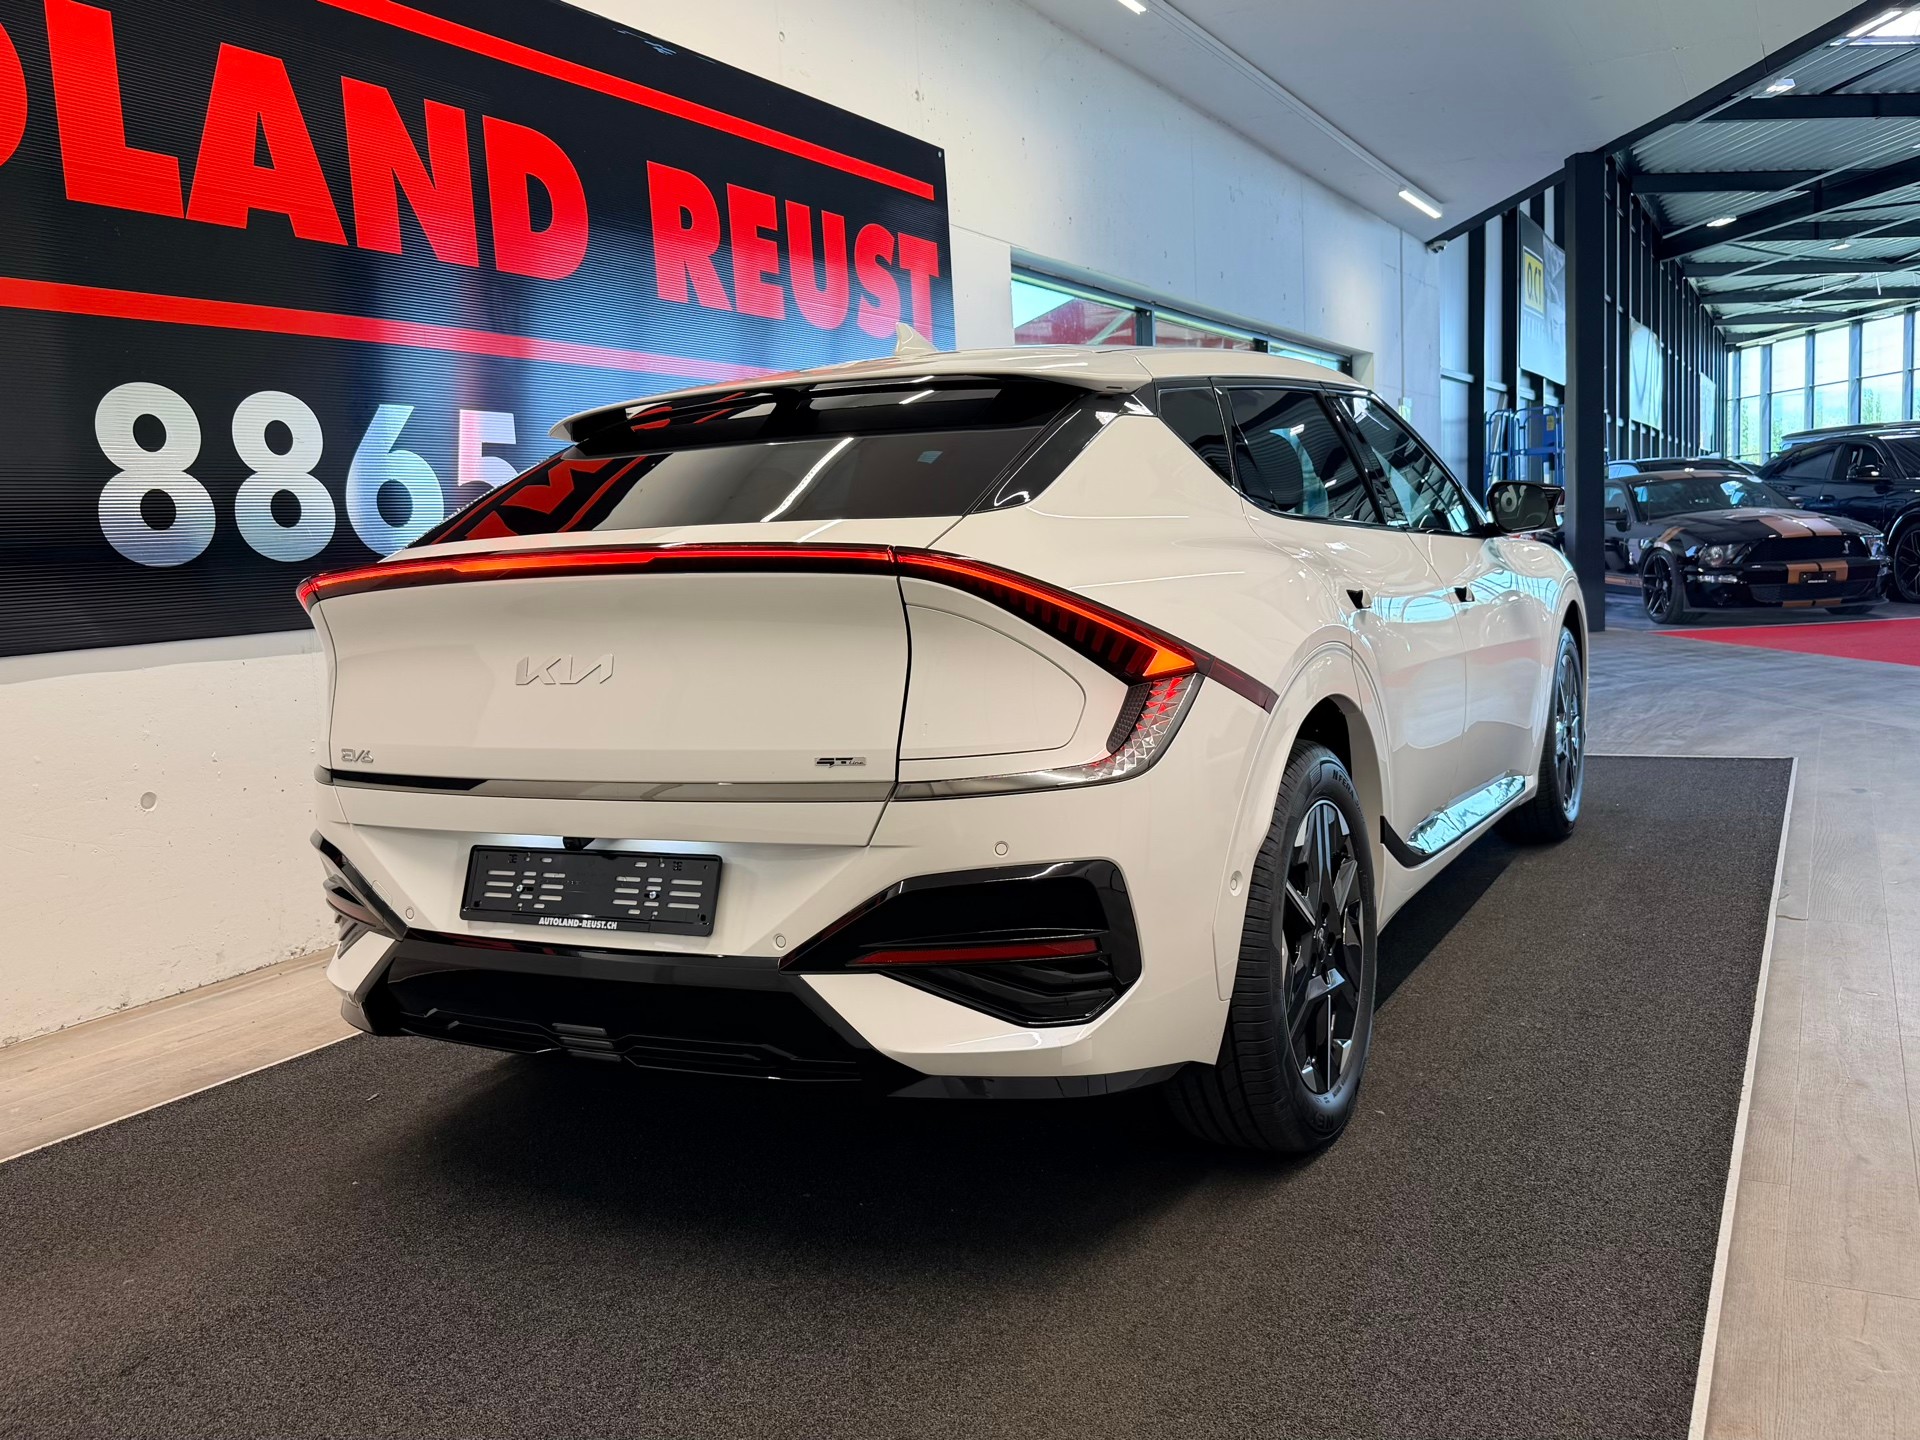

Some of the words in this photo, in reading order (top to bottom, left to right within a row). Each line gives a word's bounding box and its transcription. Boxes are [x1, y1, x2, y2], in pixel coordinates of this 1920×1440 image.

[0, 0, 589, 281] LAND
[646, 159, 940, 344] REUST
[515, 654, 615, 686] KIA
[341, 748, 375, 763] EV6
[538, 916, 618, 930] AUTOLAND-REUST.CH
